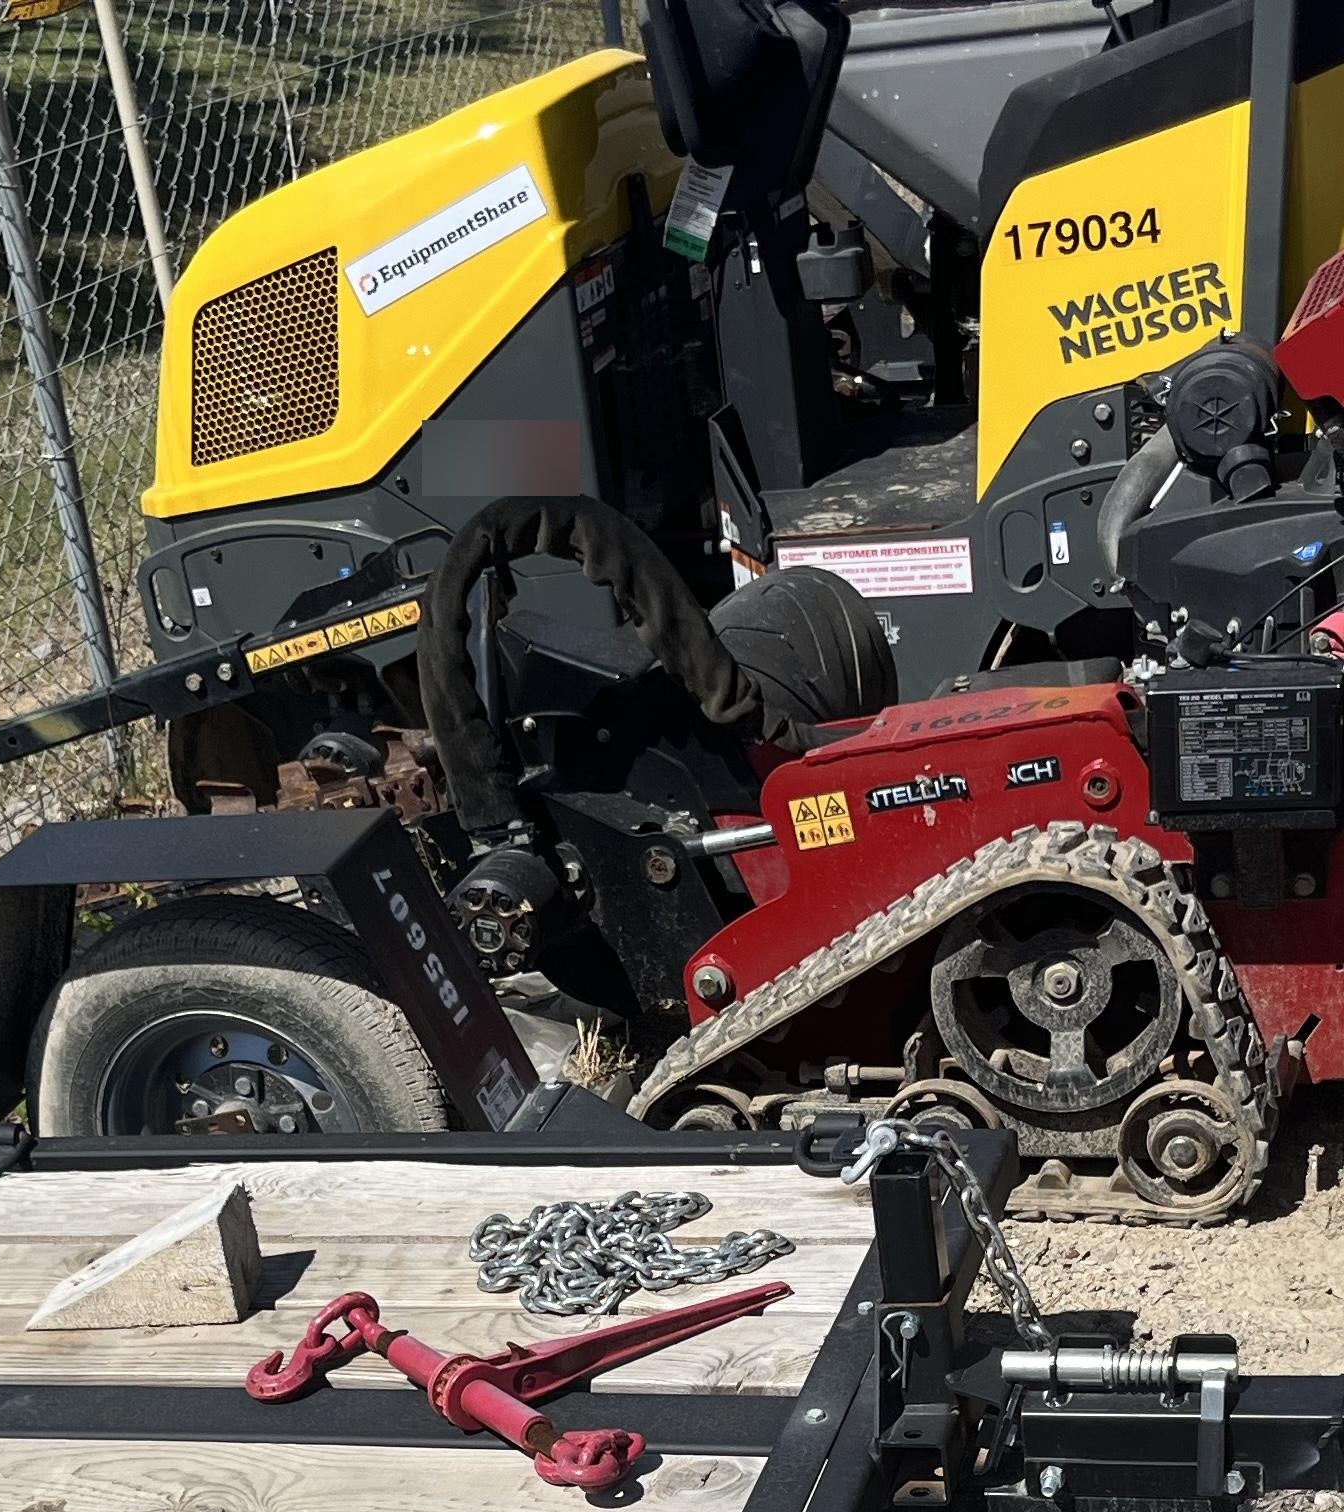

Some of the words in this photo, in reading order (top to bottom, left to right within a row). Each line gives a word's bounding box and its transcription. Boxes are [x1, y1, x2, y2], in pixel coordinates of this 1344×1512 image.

[377, 188, 529, 285] EquipmentShare
[1003, 207, 1162, 261] 179034
[1047, 261, 1227, 331] WACKER
[1058, 291, 1233, 365] NEUSON
[822, 548, 879, 561] CUSTOMER
[880, 543, 968, 559] RESPONSIBILITY
[371, 867, 470, 1027] 185607
